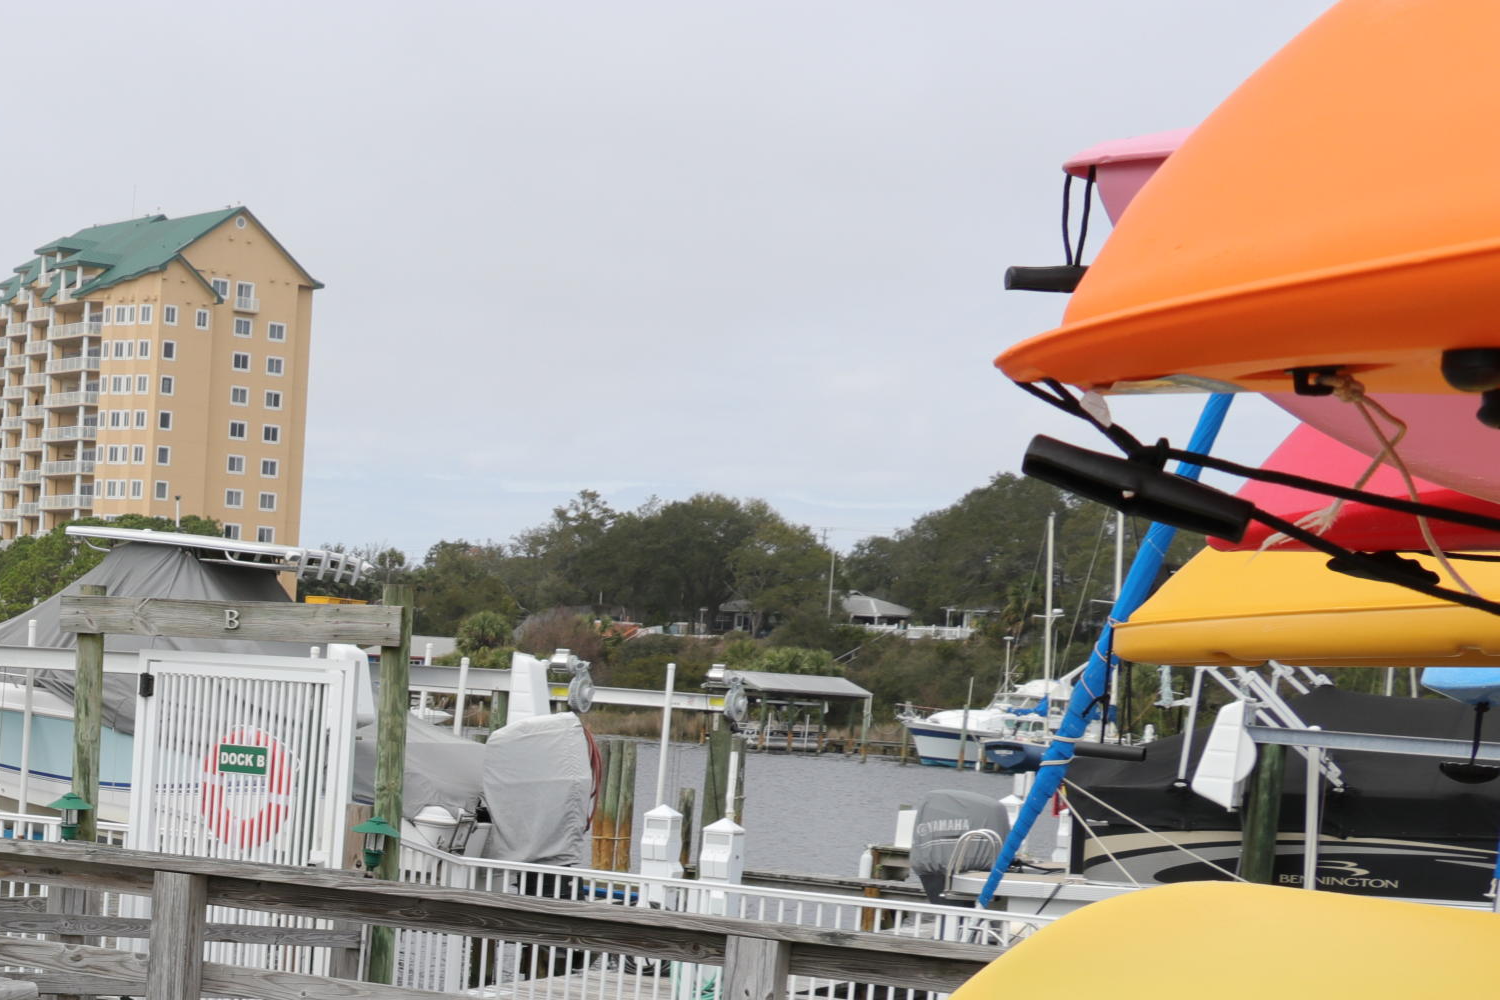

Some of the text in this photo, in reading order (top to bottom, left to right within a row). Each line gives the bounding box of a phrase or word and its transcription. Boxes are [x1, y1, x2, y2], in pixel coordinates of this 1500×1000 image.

[224, 609, 240, 629] B
[220, 752, 265, 768] DOCK B
[927, 819, 970, 832] YAMAHA
